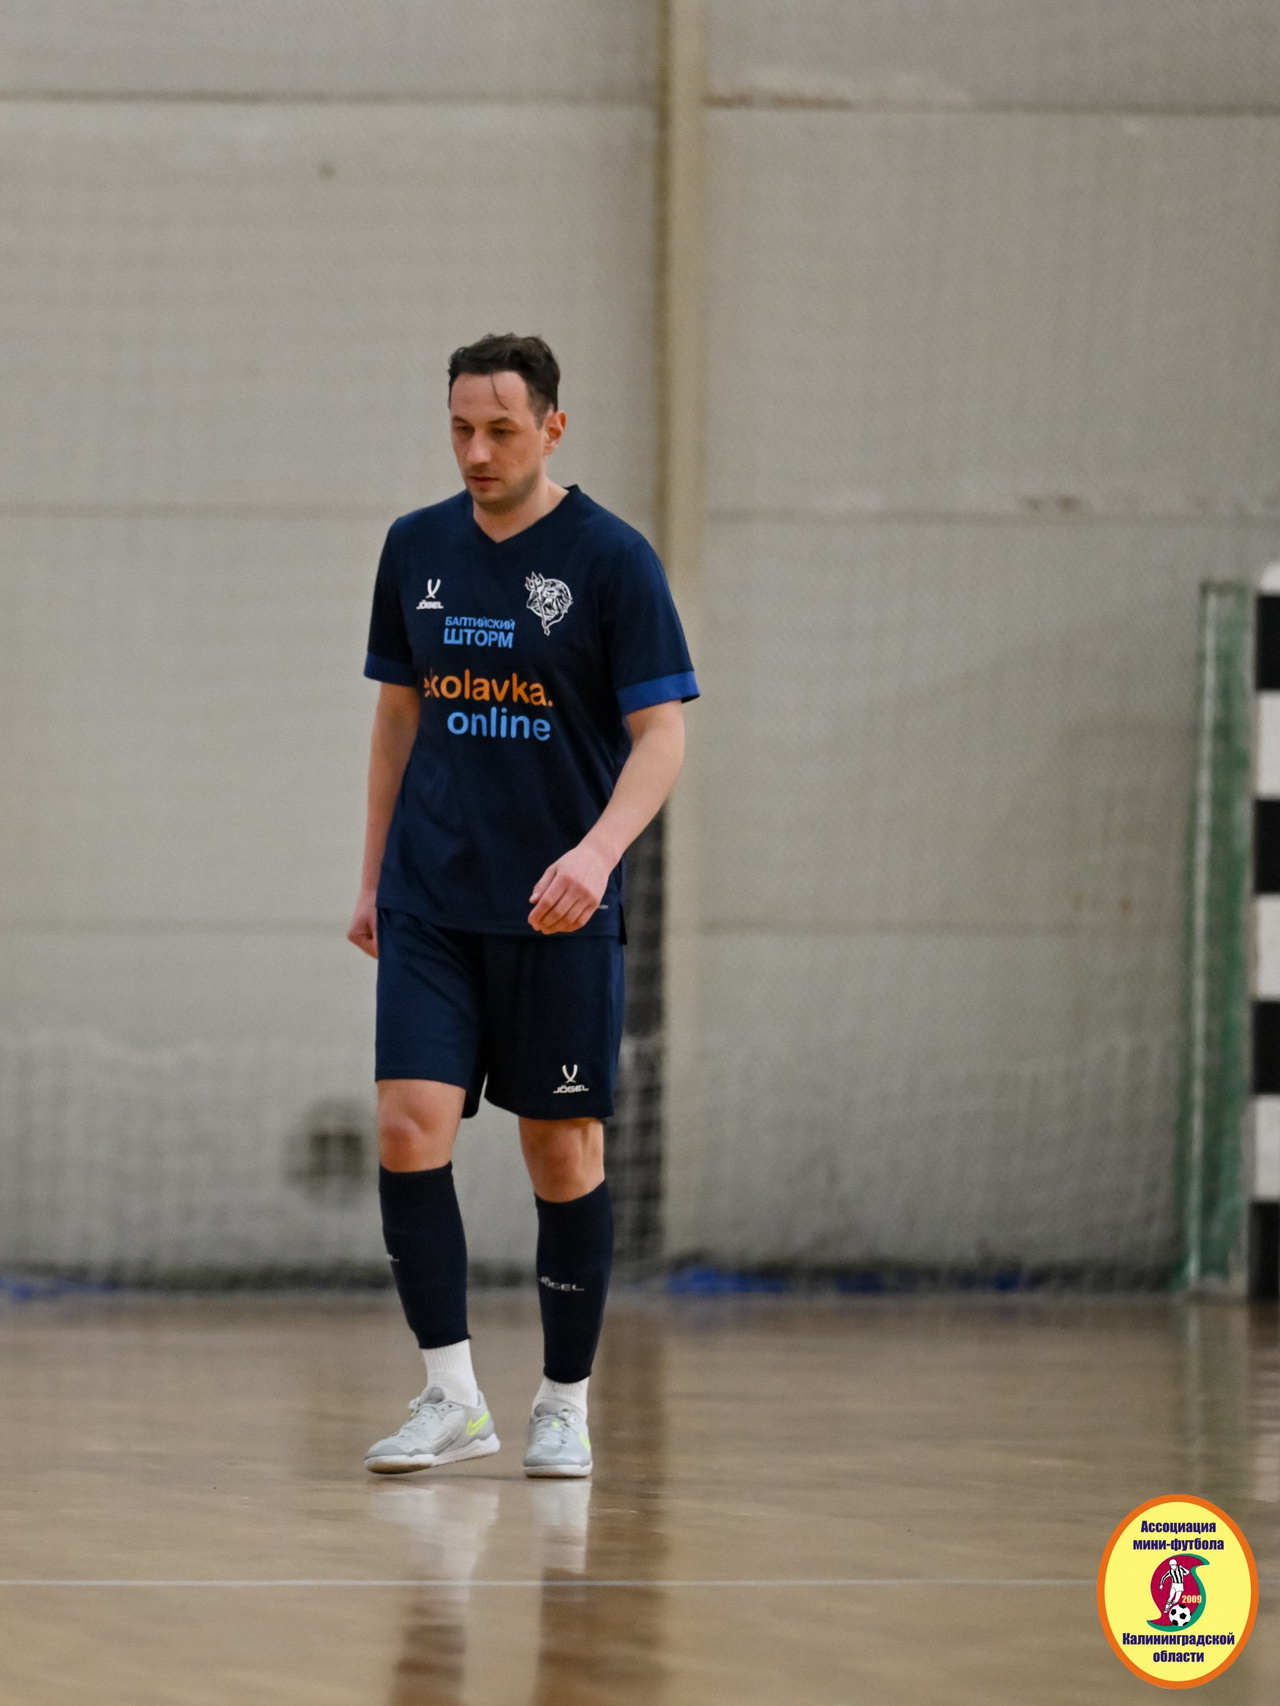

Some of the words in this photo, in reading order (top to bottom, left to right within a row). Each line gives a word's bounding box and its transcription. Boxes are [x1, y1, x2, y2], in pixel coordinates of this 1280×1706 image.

[445, 616, 515, 631] БАЛТИЙСКИЙ
[444, 628, 513, 649] ШТОРМ
[447, 706, 551, 741] online
